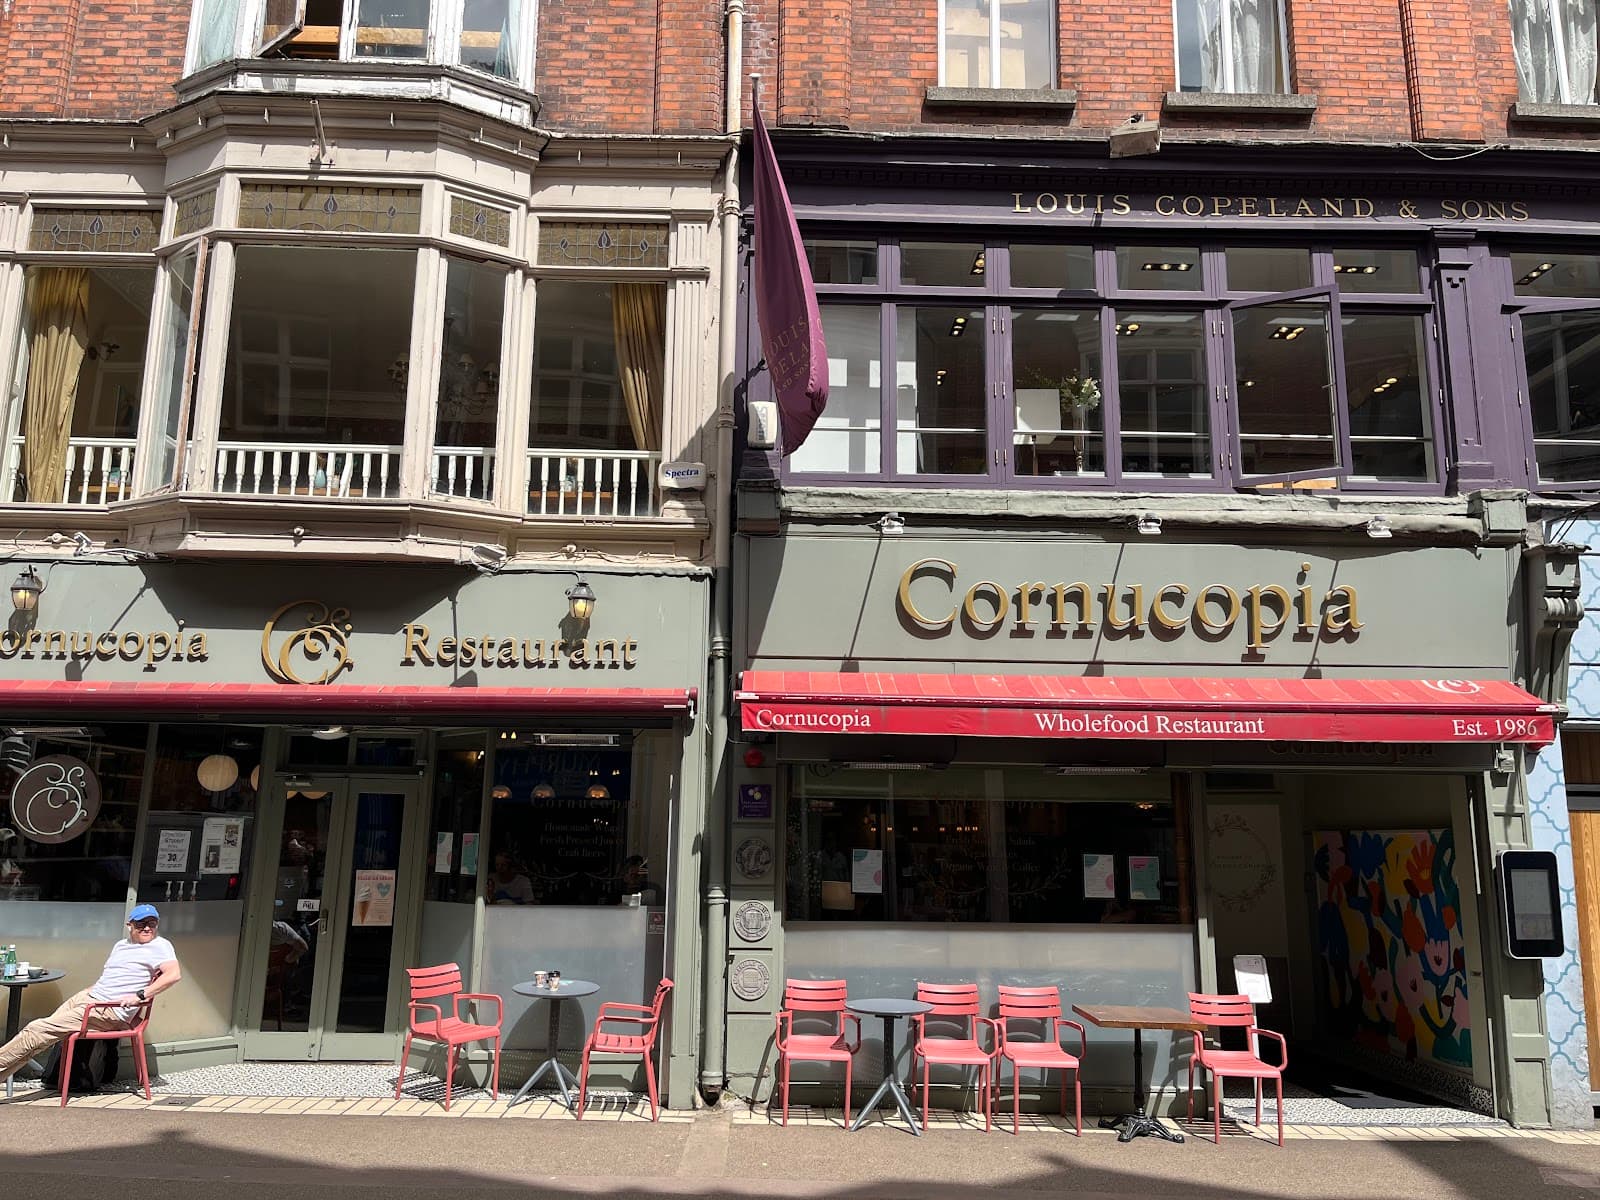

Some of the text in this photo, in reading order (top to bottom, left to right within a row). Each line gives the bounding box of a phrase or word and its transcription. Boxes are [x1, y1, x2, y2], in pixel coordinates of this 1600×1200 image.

[1011, 192, 1530, 221] LOUIS COPELAND & SONS
[664, 468, 699, 479] Spectra
[898, 557, 1365, 649] Cornucopia
[0, 618, 208, 667] ornucopia
[402, 622, 637, 664] Restaurant
[756, 708, 1538, 737] Cornucopia Wholefood Restaurant Est. 1986
